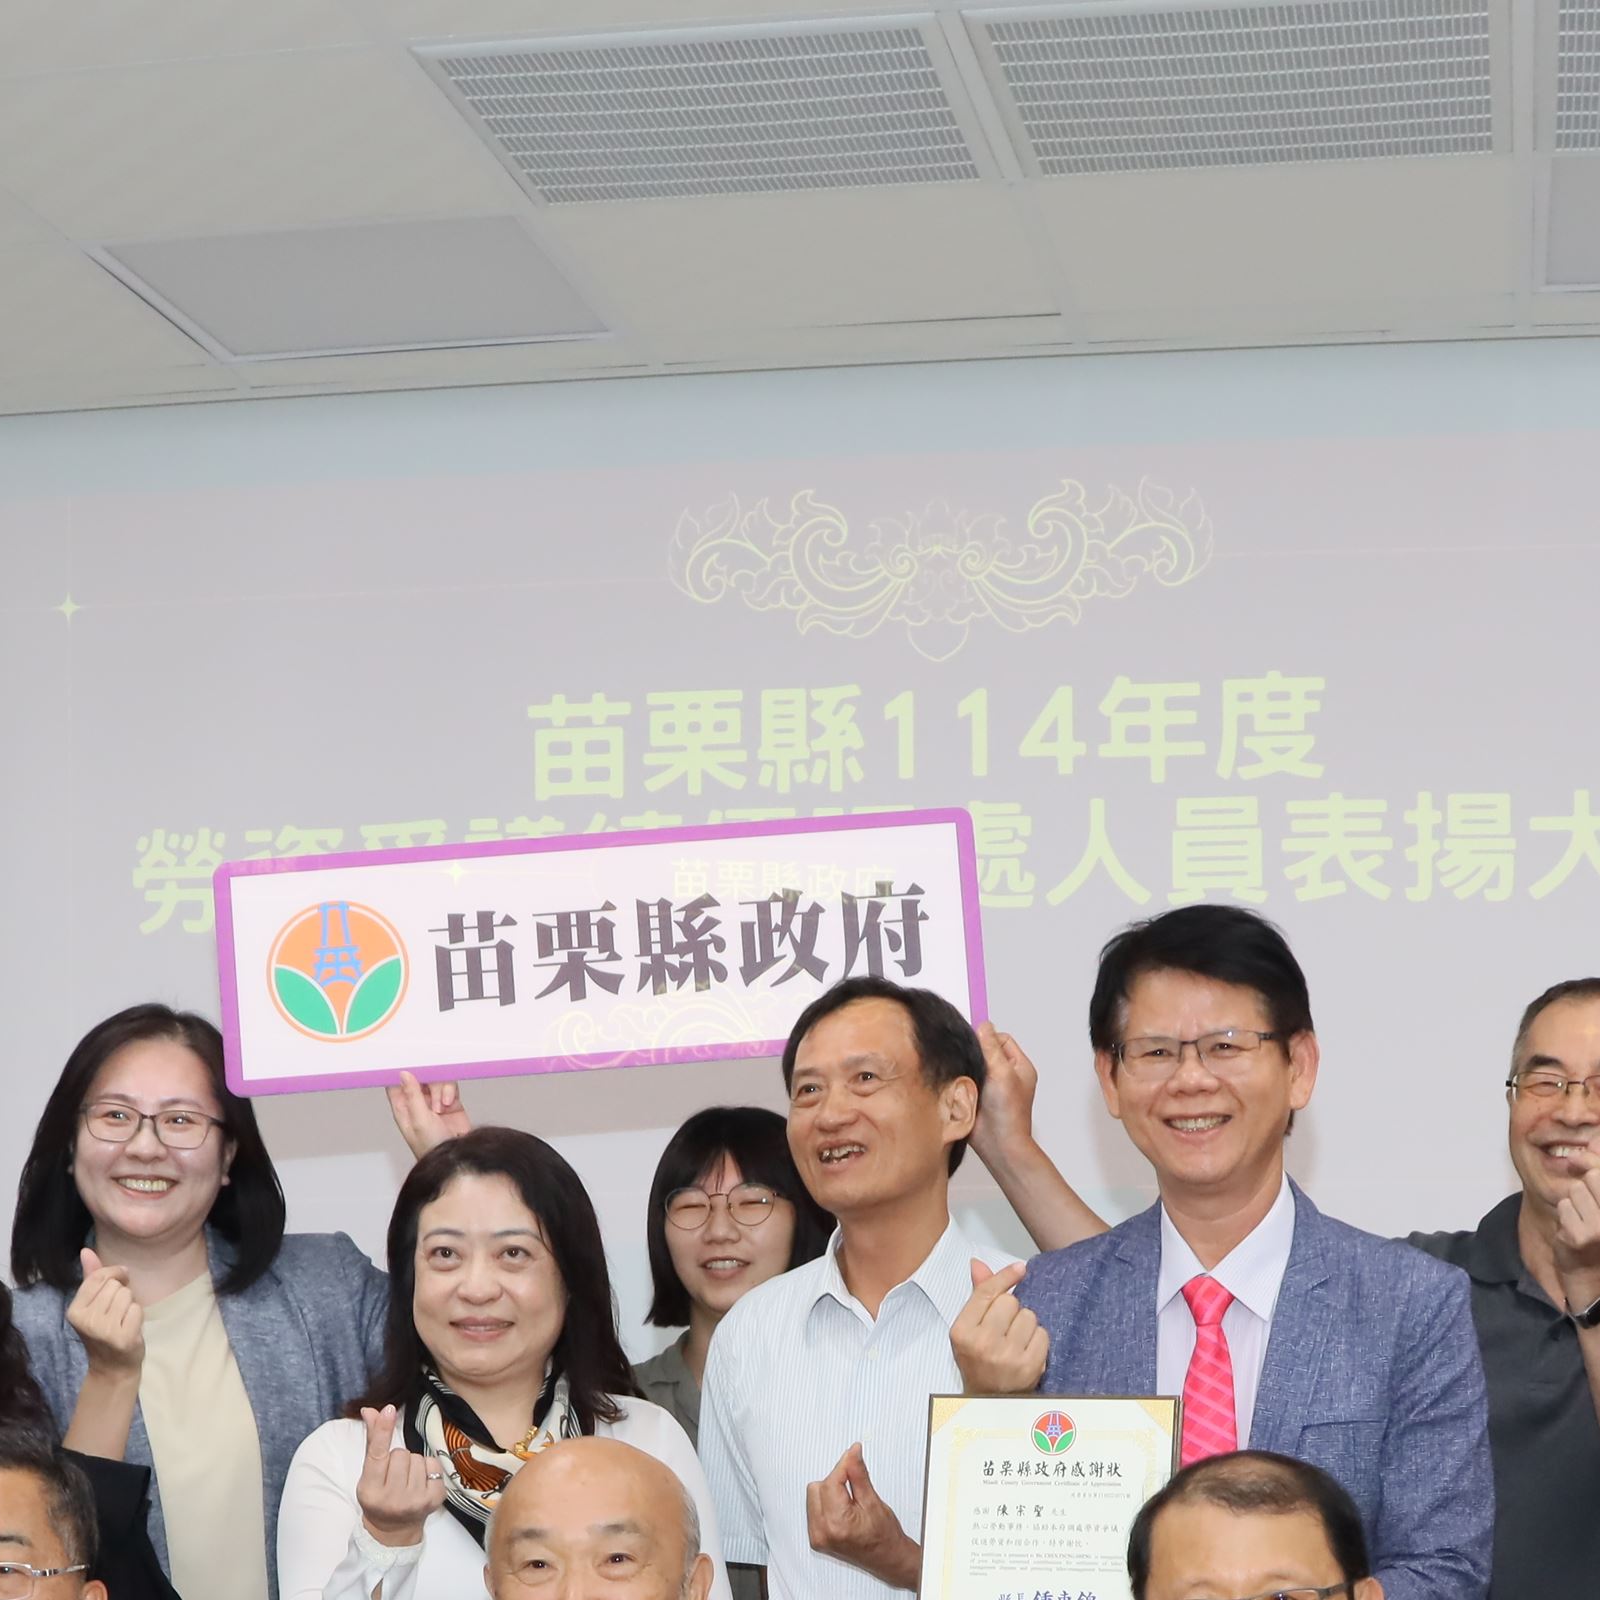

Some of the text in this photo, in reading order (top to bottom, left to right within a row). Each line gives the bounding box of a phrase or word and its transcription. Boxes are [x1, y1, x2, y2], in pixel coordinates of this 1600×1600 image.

[527, 670, 1326, 802] 苗栗縣114年度
[428, 881, 930, 1012] 苗栗縣政府
[983, 1460, 1123, 1478] 苗栗縣政府感謝狀
